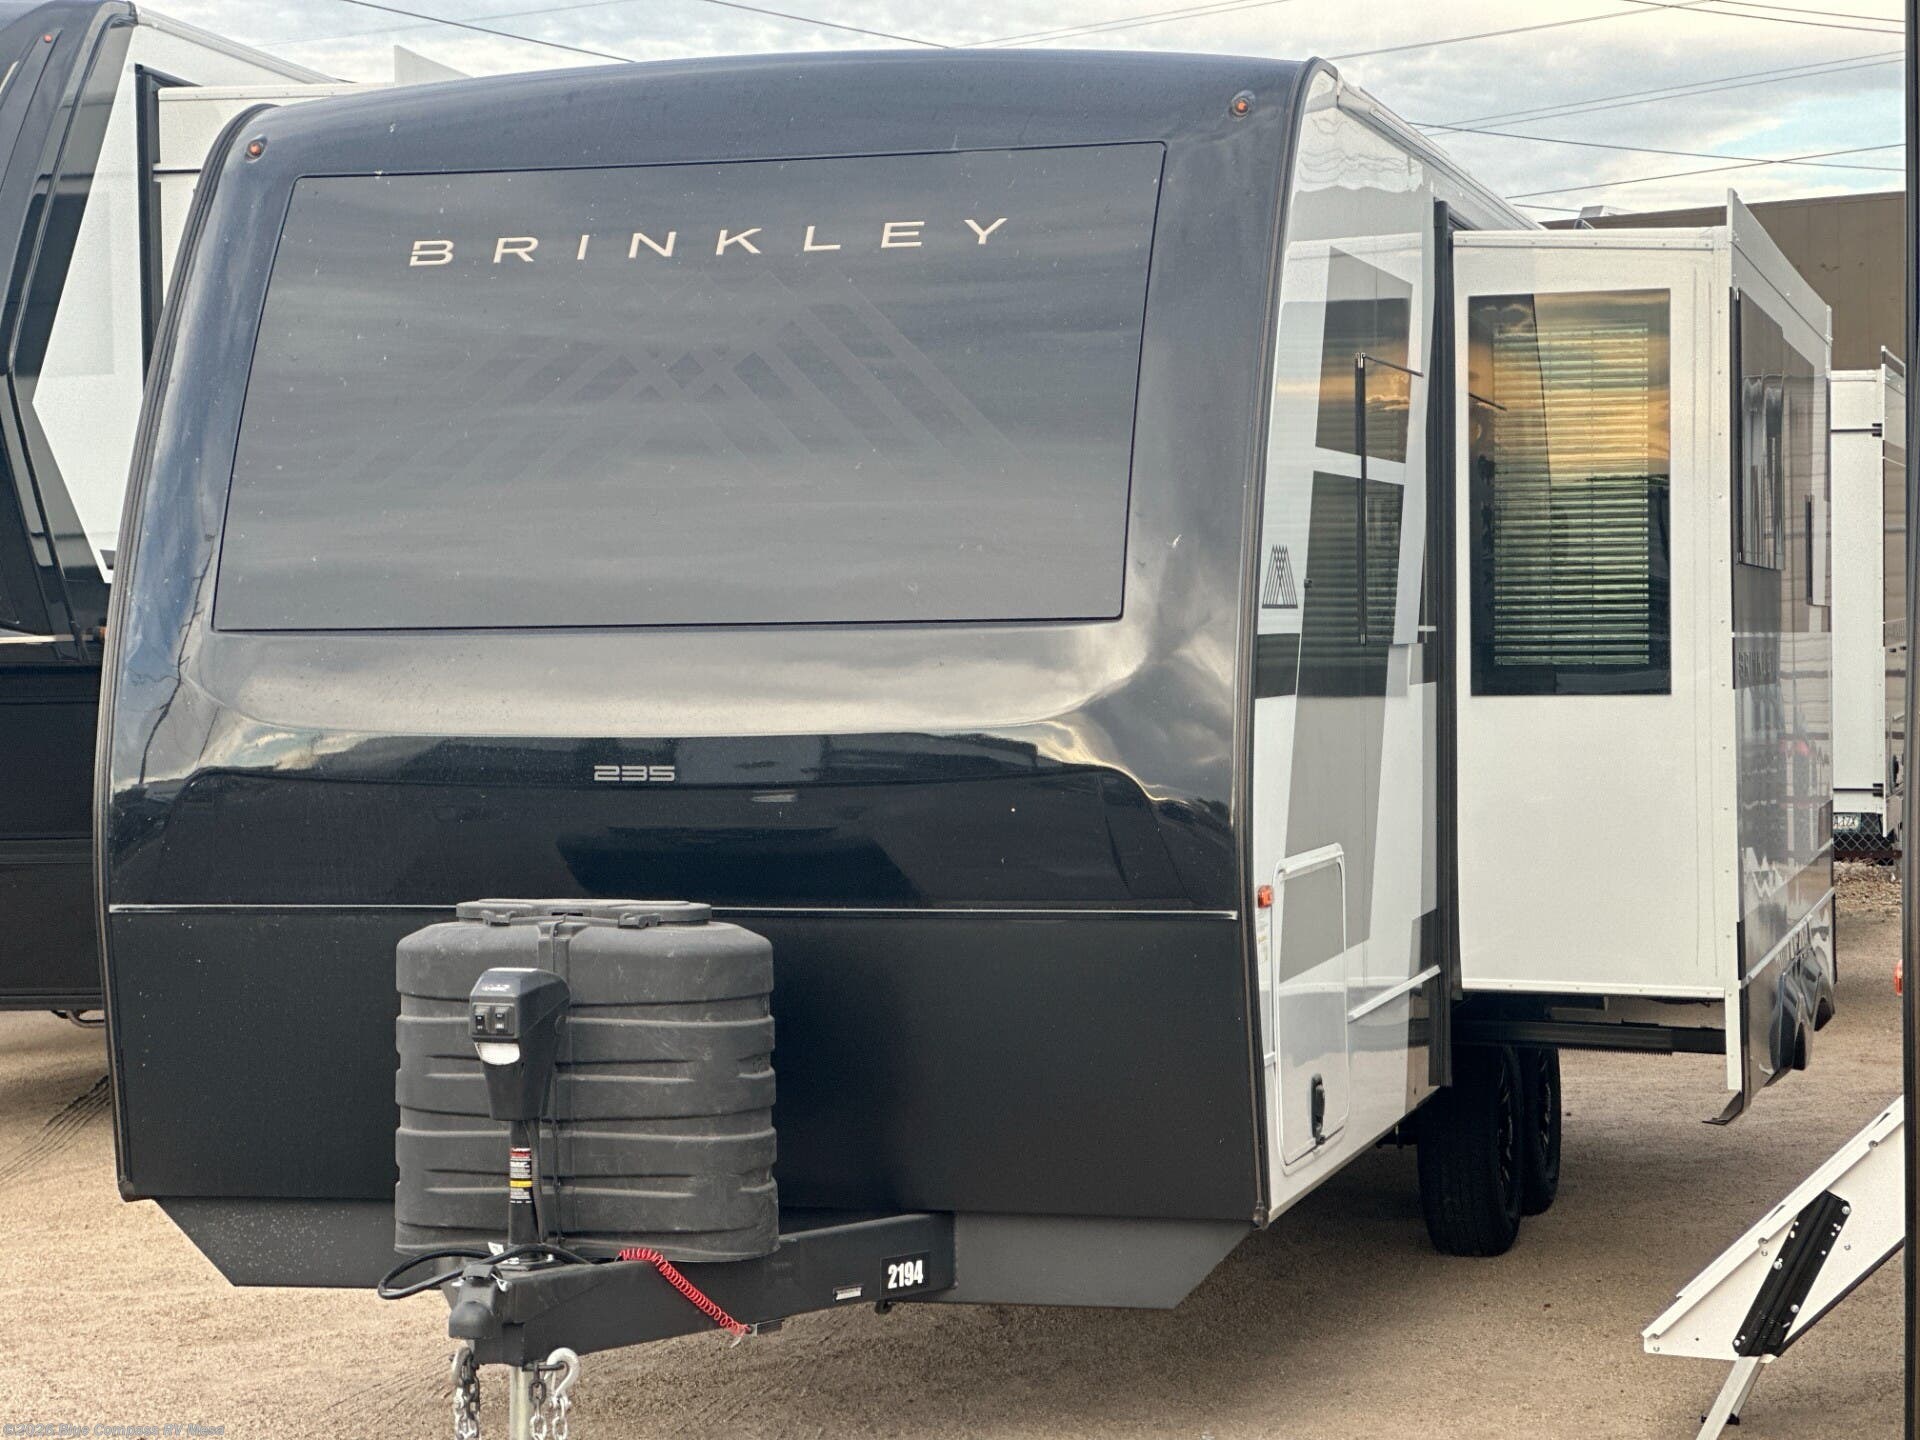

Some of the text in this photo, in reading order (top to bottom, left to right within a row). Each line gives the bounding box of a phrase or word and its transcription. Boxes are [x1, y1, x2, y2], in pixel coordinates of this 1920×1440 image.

[409, 217, 1009, 267] BRINKLEY
[593, 765, 676, 782] 235
[887, 1259, 924, 1290] 2194
